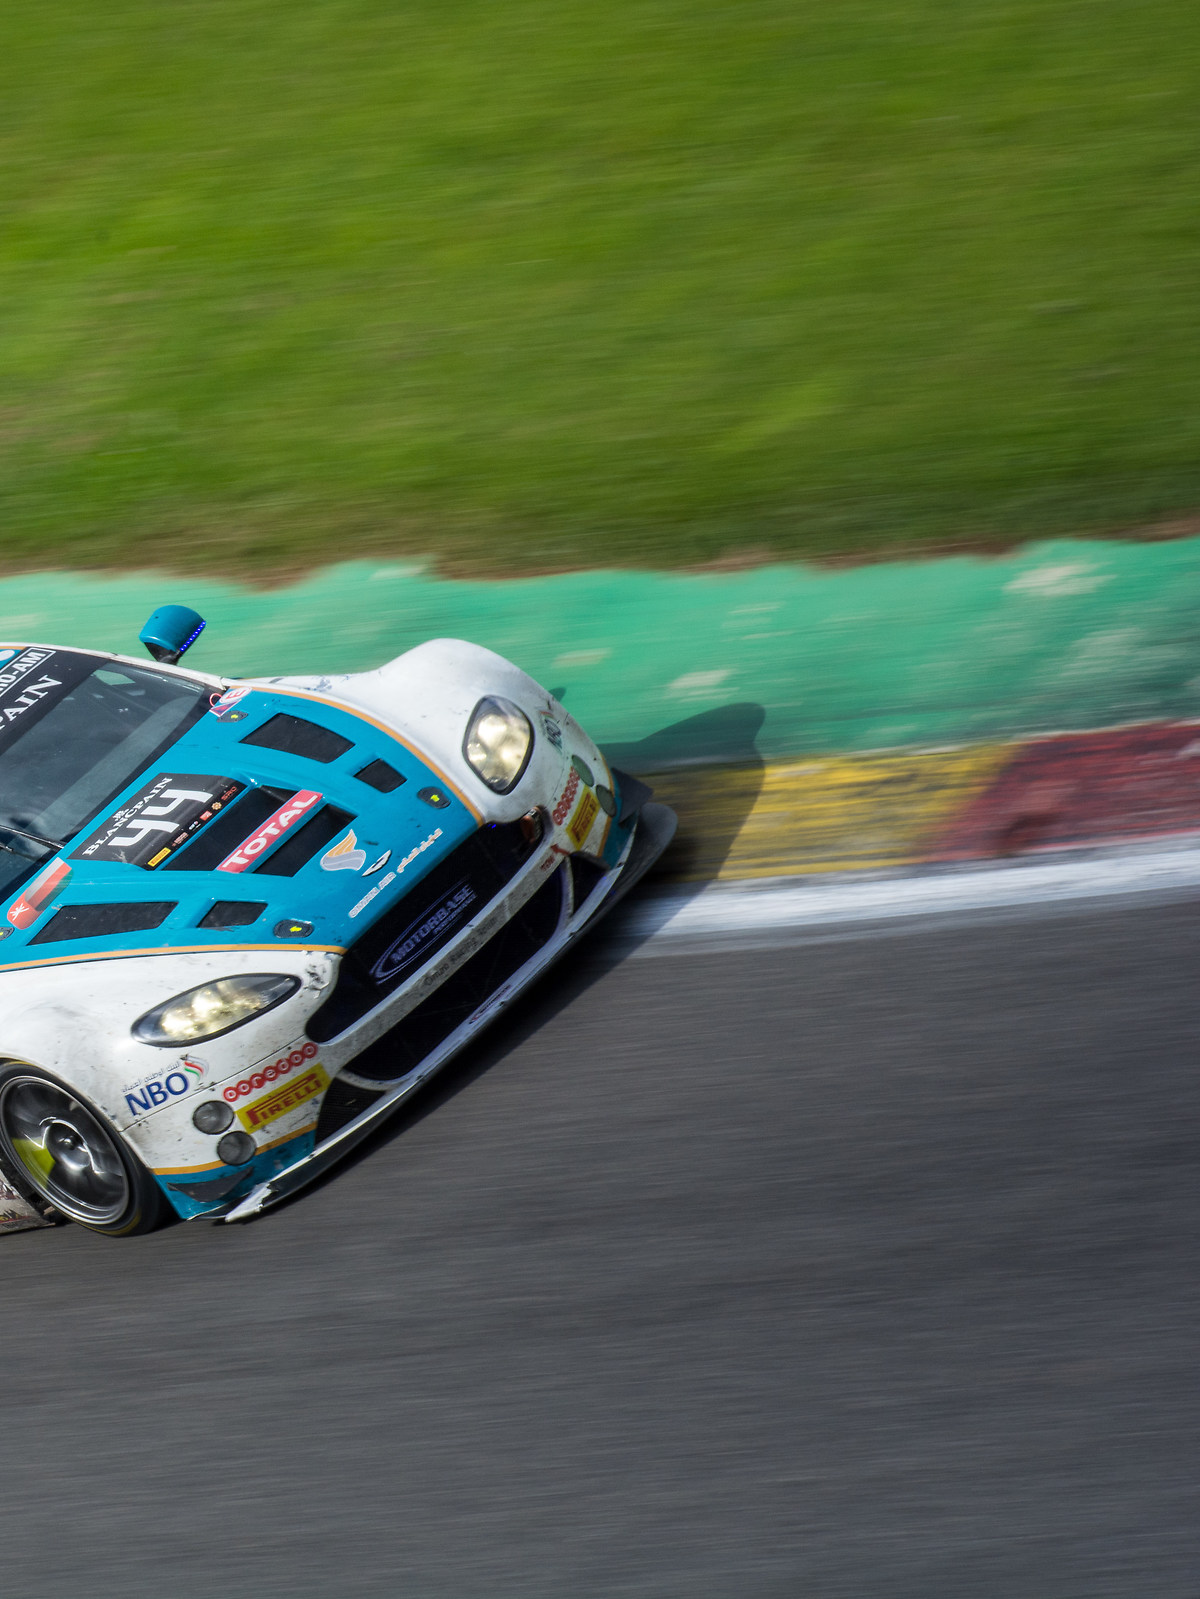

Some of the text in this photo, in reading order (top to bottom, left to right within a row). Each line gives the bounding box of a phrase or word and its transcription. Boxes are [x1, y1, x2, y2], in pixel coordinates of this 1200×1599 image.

[82, 777, 172, 856] BLANCPAIN
[108, 789, 213, 847] 44
[220, 791, 317, 867] TOTAL
[348, 871, 396, 918] OMAN AIR
[391, 884, 475, 965] MOTORBASE
[124, 1072, 190, 1116] NBO
[223, 1042, 318, 1102] ooredoo
[246, 1072, 322, 1126] PIRELLI
